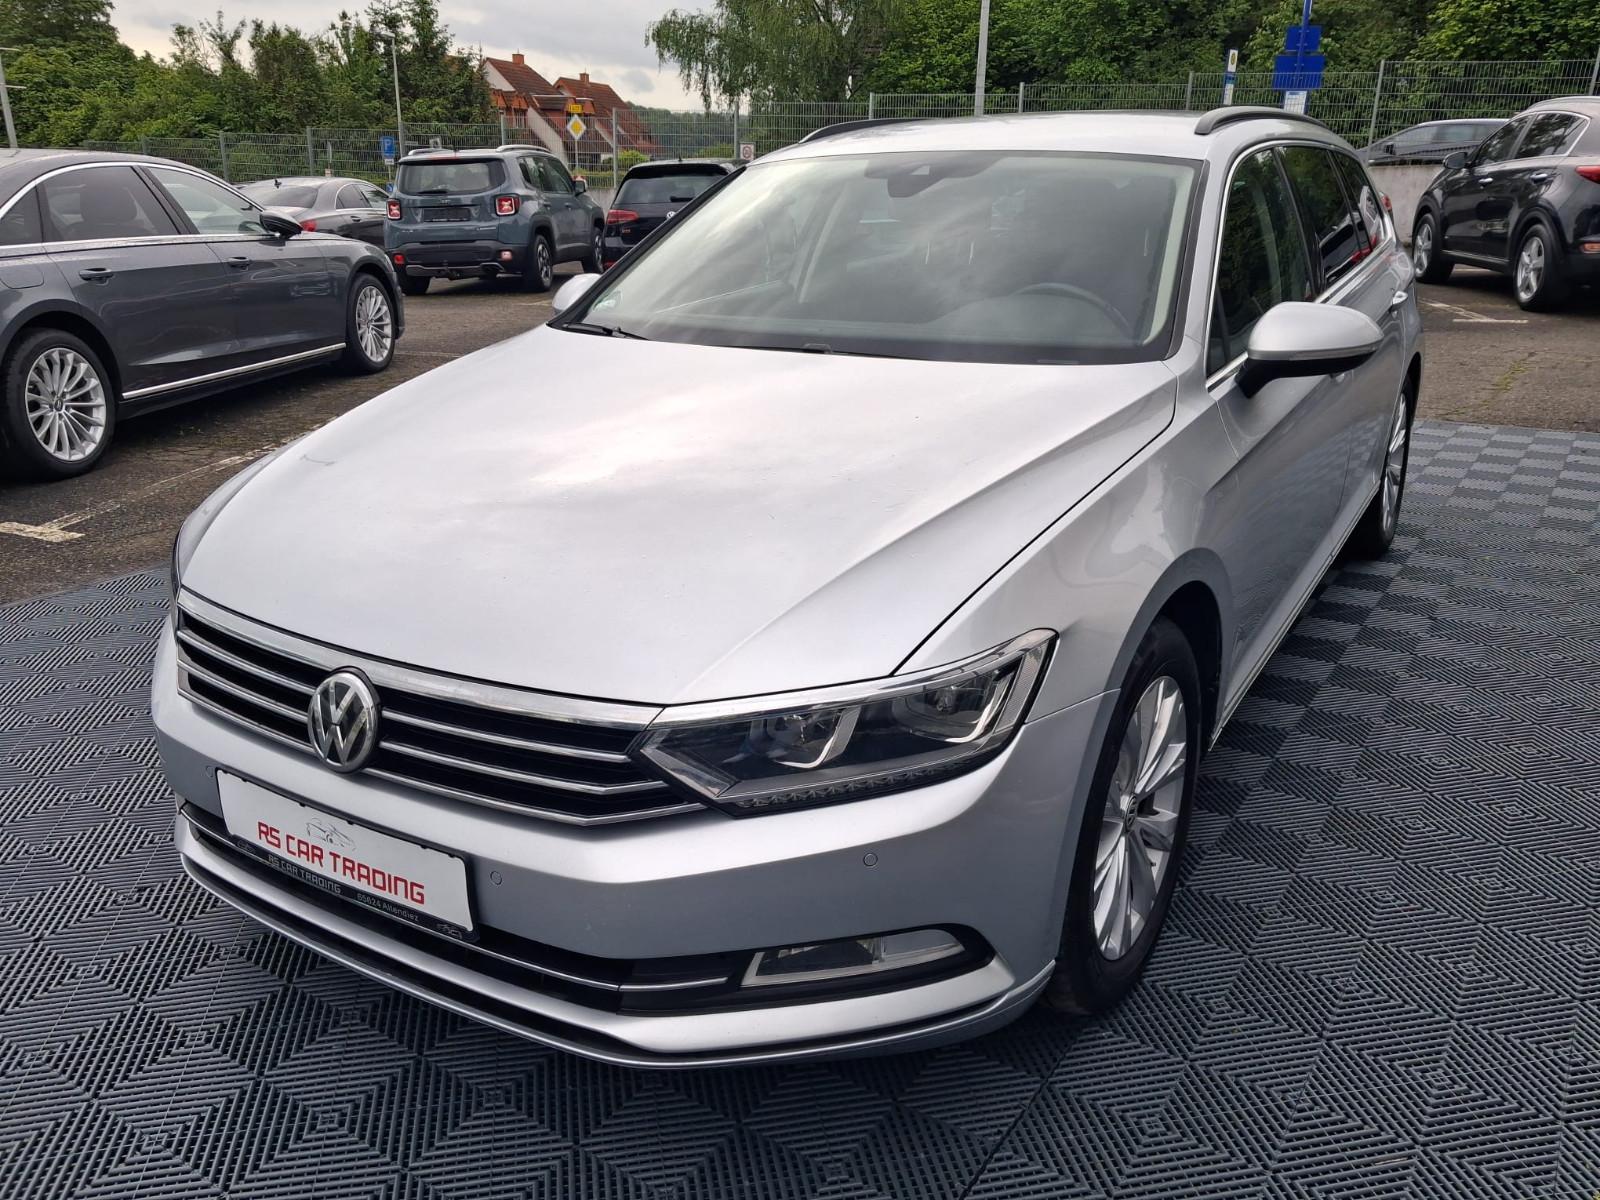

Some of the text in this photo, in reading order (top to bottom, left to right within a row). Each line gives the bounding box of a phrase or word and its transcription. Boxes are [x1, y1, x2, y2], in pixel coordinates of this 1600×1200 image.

[384, 138, 392, 151] P
[258, 821, 425, 905] RS CAR TRADING
[268, 854, 341, 894] RS CAR TRADING
